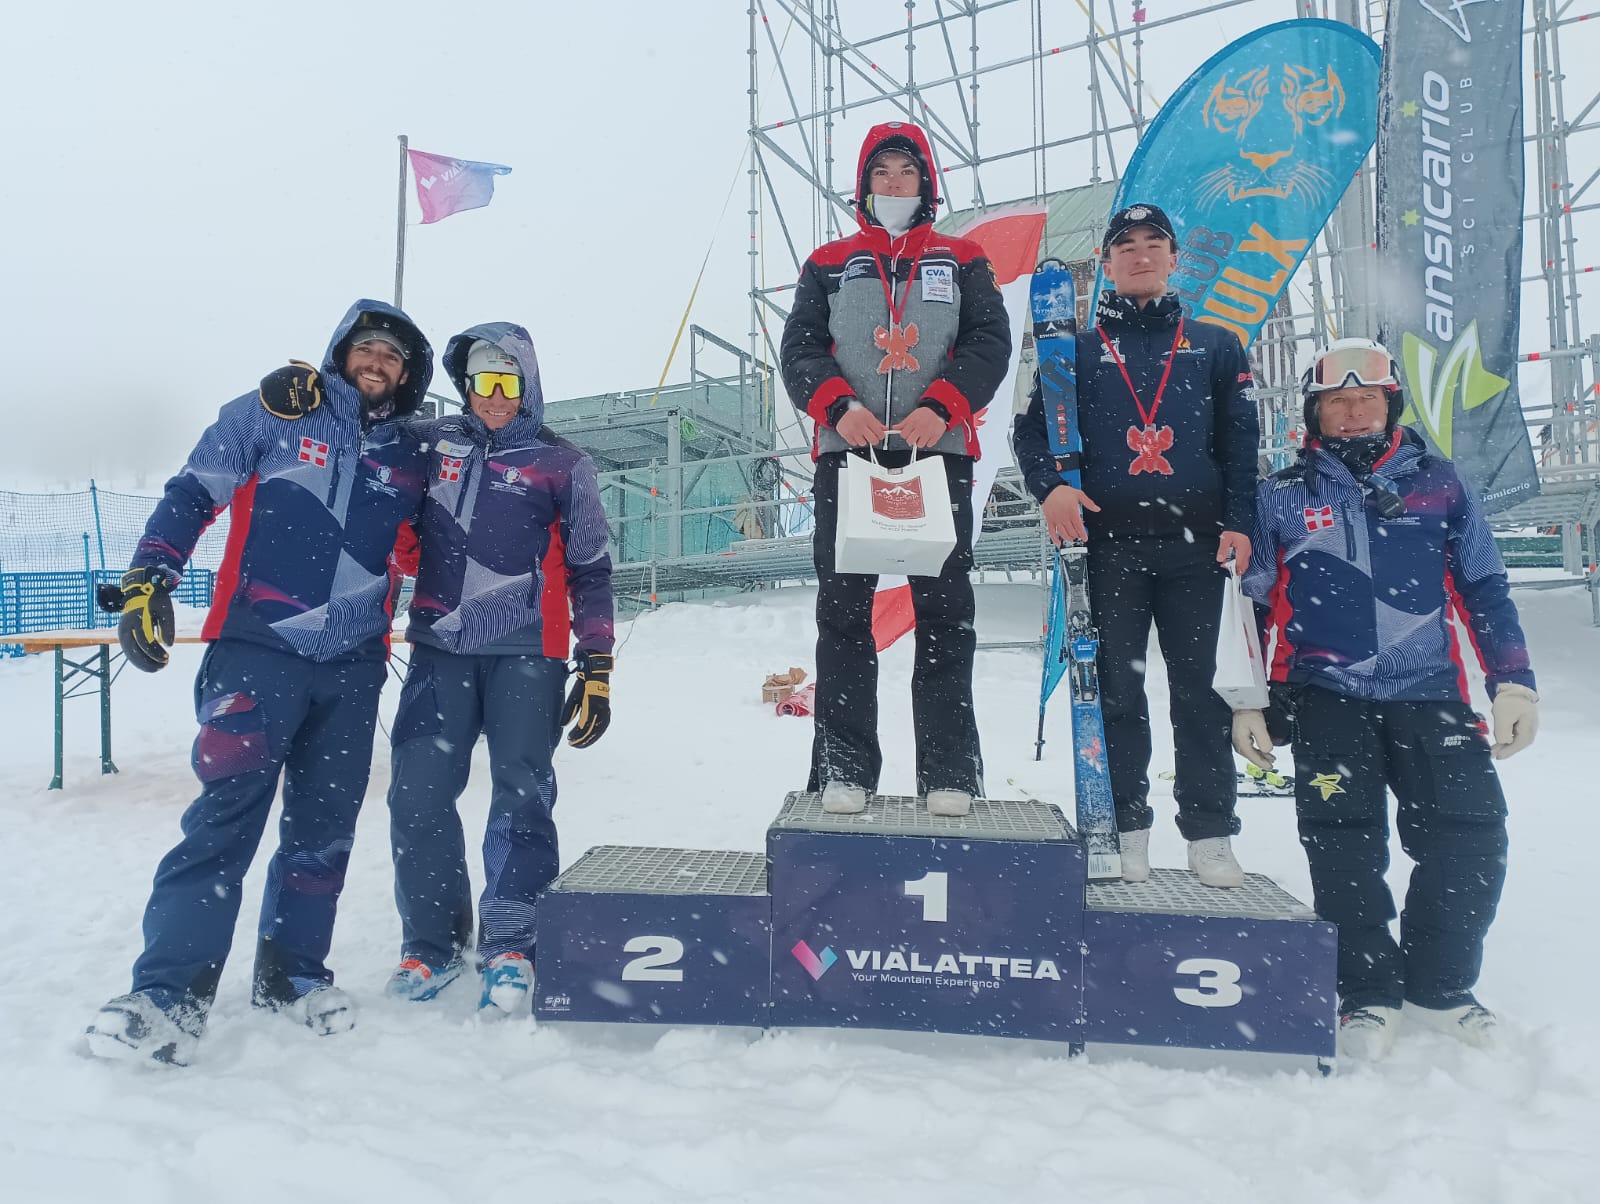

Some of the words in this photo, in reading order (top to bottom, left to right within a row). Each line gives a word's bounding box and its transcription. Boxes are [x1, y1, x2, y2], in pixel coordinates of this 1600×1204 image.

[1459, 76, 1474, 164] CLUB
[1461, 197, 1476, 256] SCI
[926, 269, 946, 277] CVA
[1096, 304, 1124, 320] uvex
[904, 871, 948, 922] 1
[621, 935, 684, 982] 2
[846, 949, 1062, 981] VIALATTEA
[851, 972, 877, 983] Your
[880, 974, 932, 985] Mountain
[935, 976, 1000, 989] Experience
[1173, 958, 1243, 1008] 3
